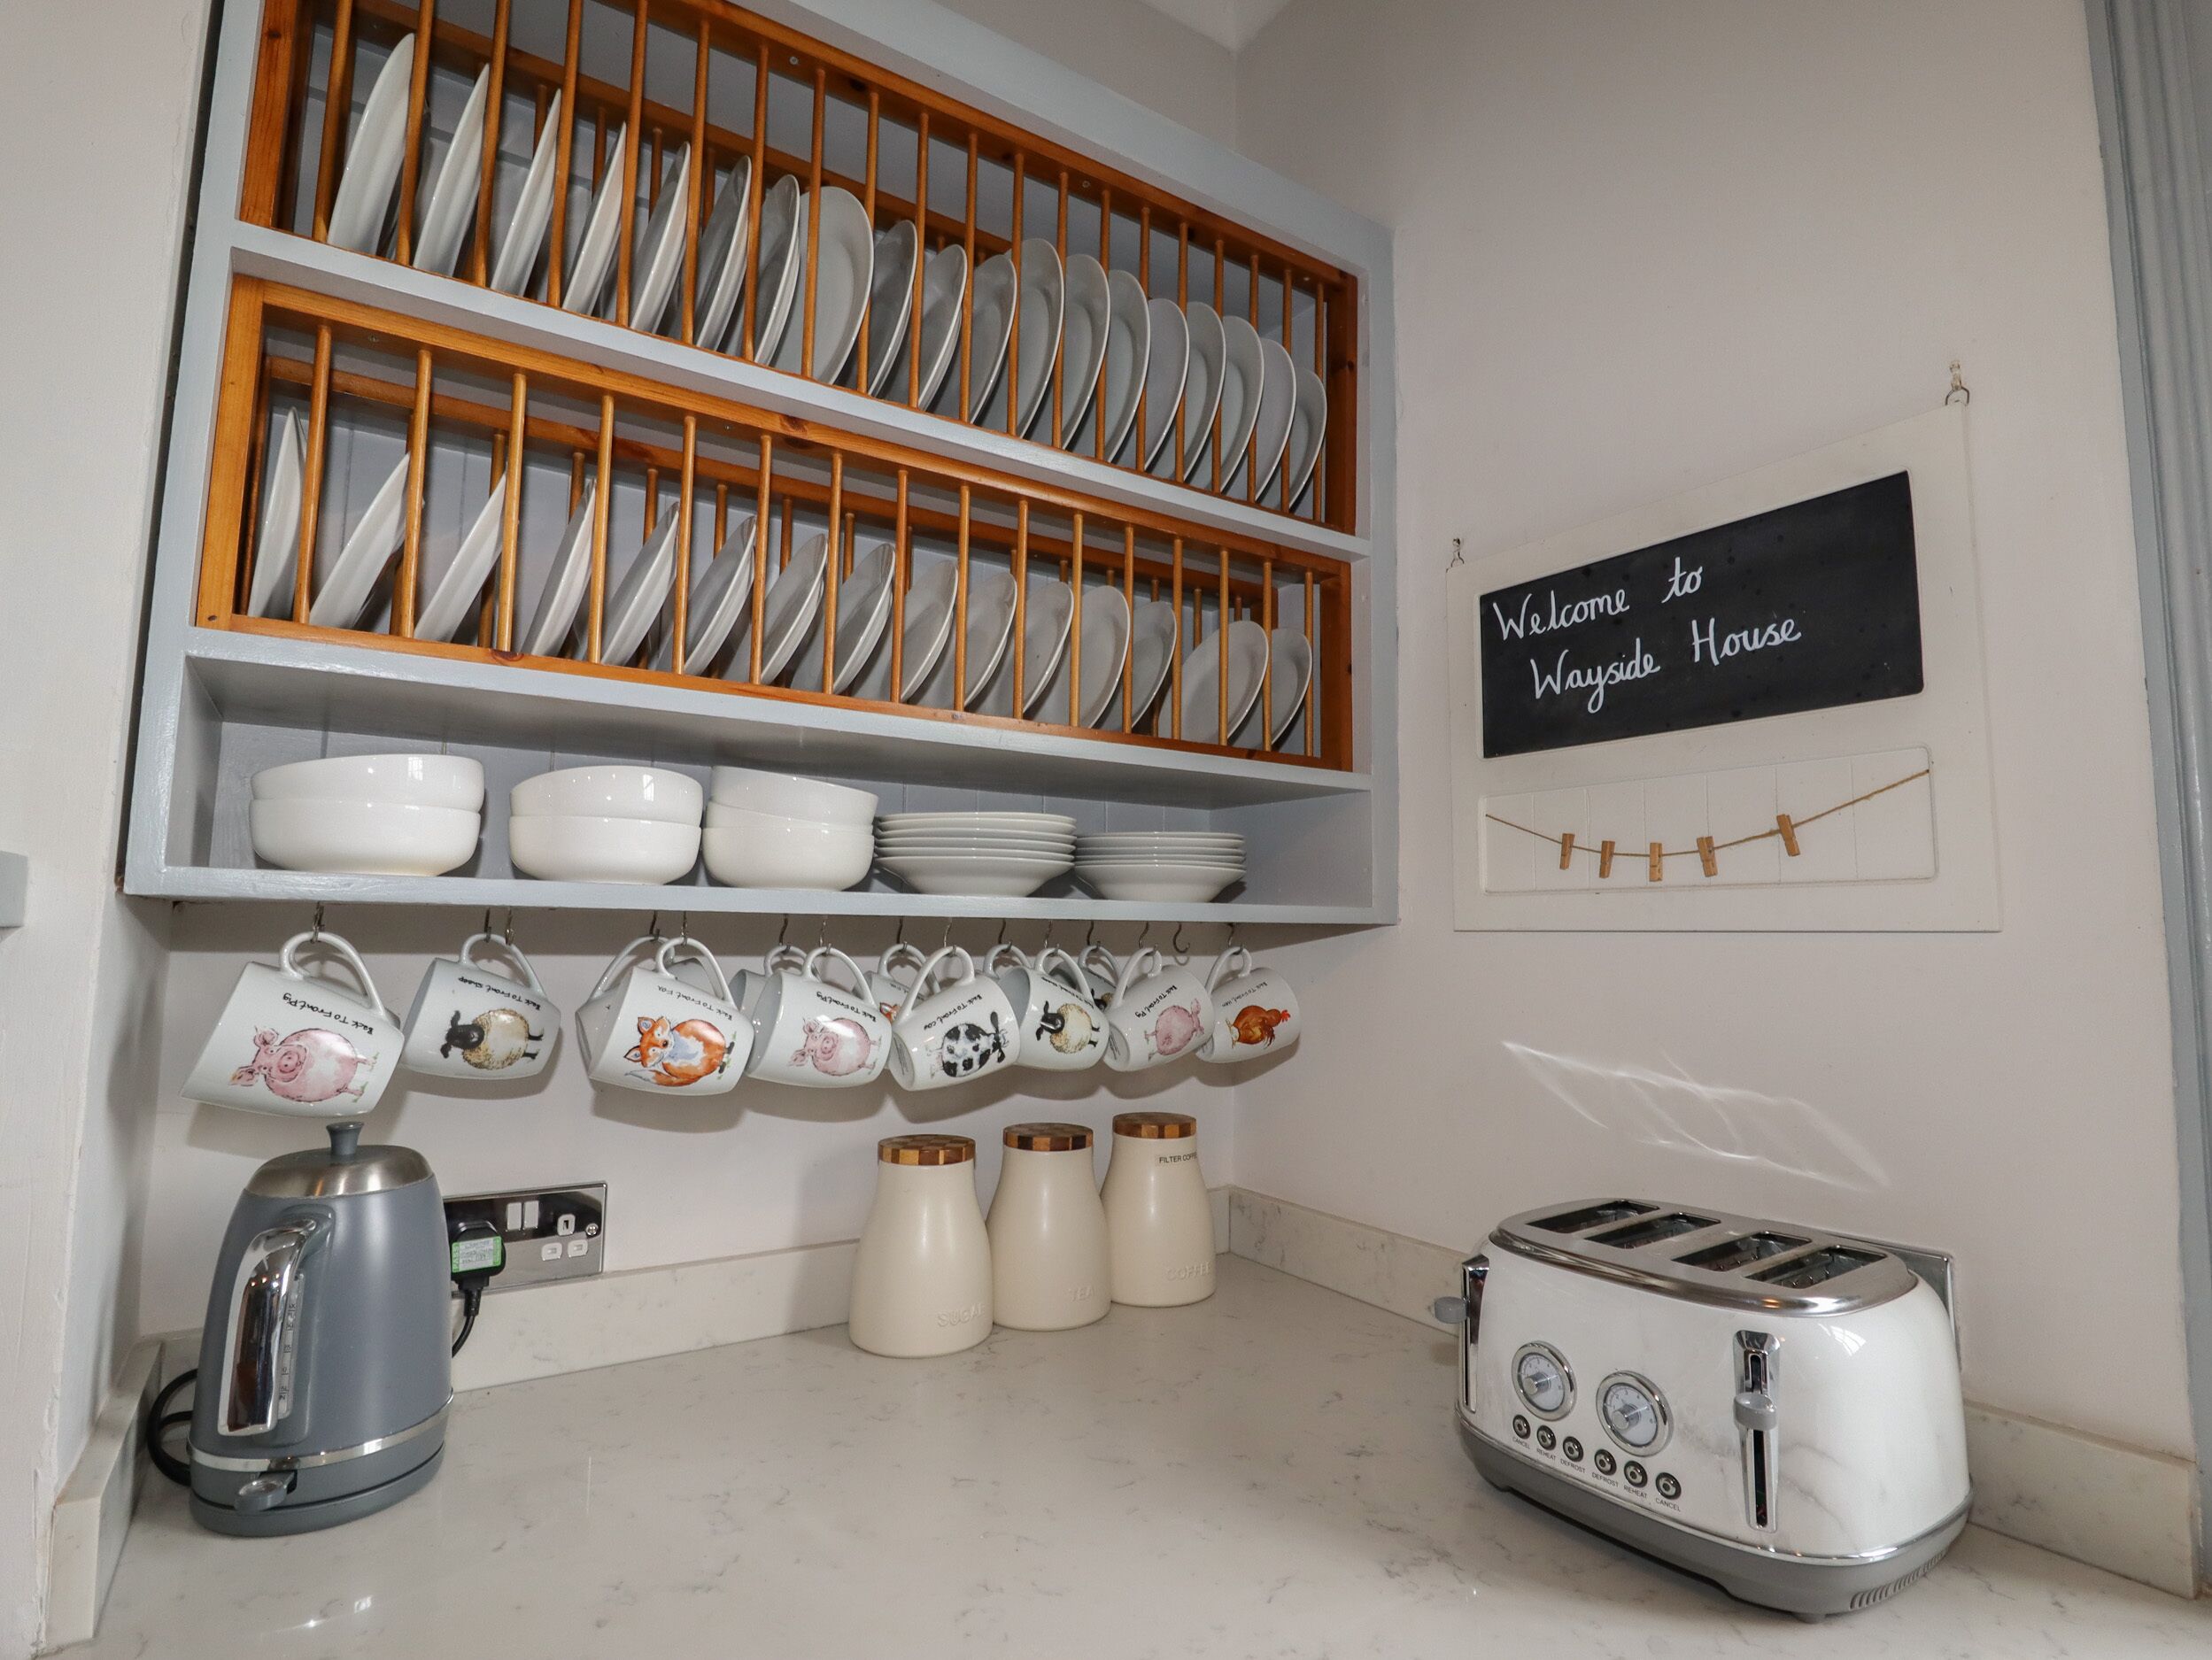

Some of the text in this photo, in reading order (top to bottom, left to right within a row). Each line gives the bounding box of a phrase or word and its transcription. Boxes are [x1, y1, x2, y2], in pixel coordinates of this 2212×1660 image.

[1493, 556, 1704, 641] Welcome to
[1530, 617, 1802, 714] Wayside House
[485, 984, 511, 998] Front
[676, 992, 701, 1005] Front
[282, 992, 298, 1008] Pig
[525, 999, 541, 1011] Back
[827, 996, 849, 1009] Front
[298, 1000, 332, 1017] Front
[936, 1008, 957, 1023] Front
[352, 1020, 374, 1035] Back
[1159, 1154, 1182, 1163] FILTER
[1536, 1448, 1556, 1460] REHEAT
[1560, 1458, 1585, 1473] DEFROST
[1591, 1471, 1619, 1487] DEFROST
[1623, 1485, 1647, 1498] REHEAT
[1655, 1497, 1681, 1512] CANCEL
